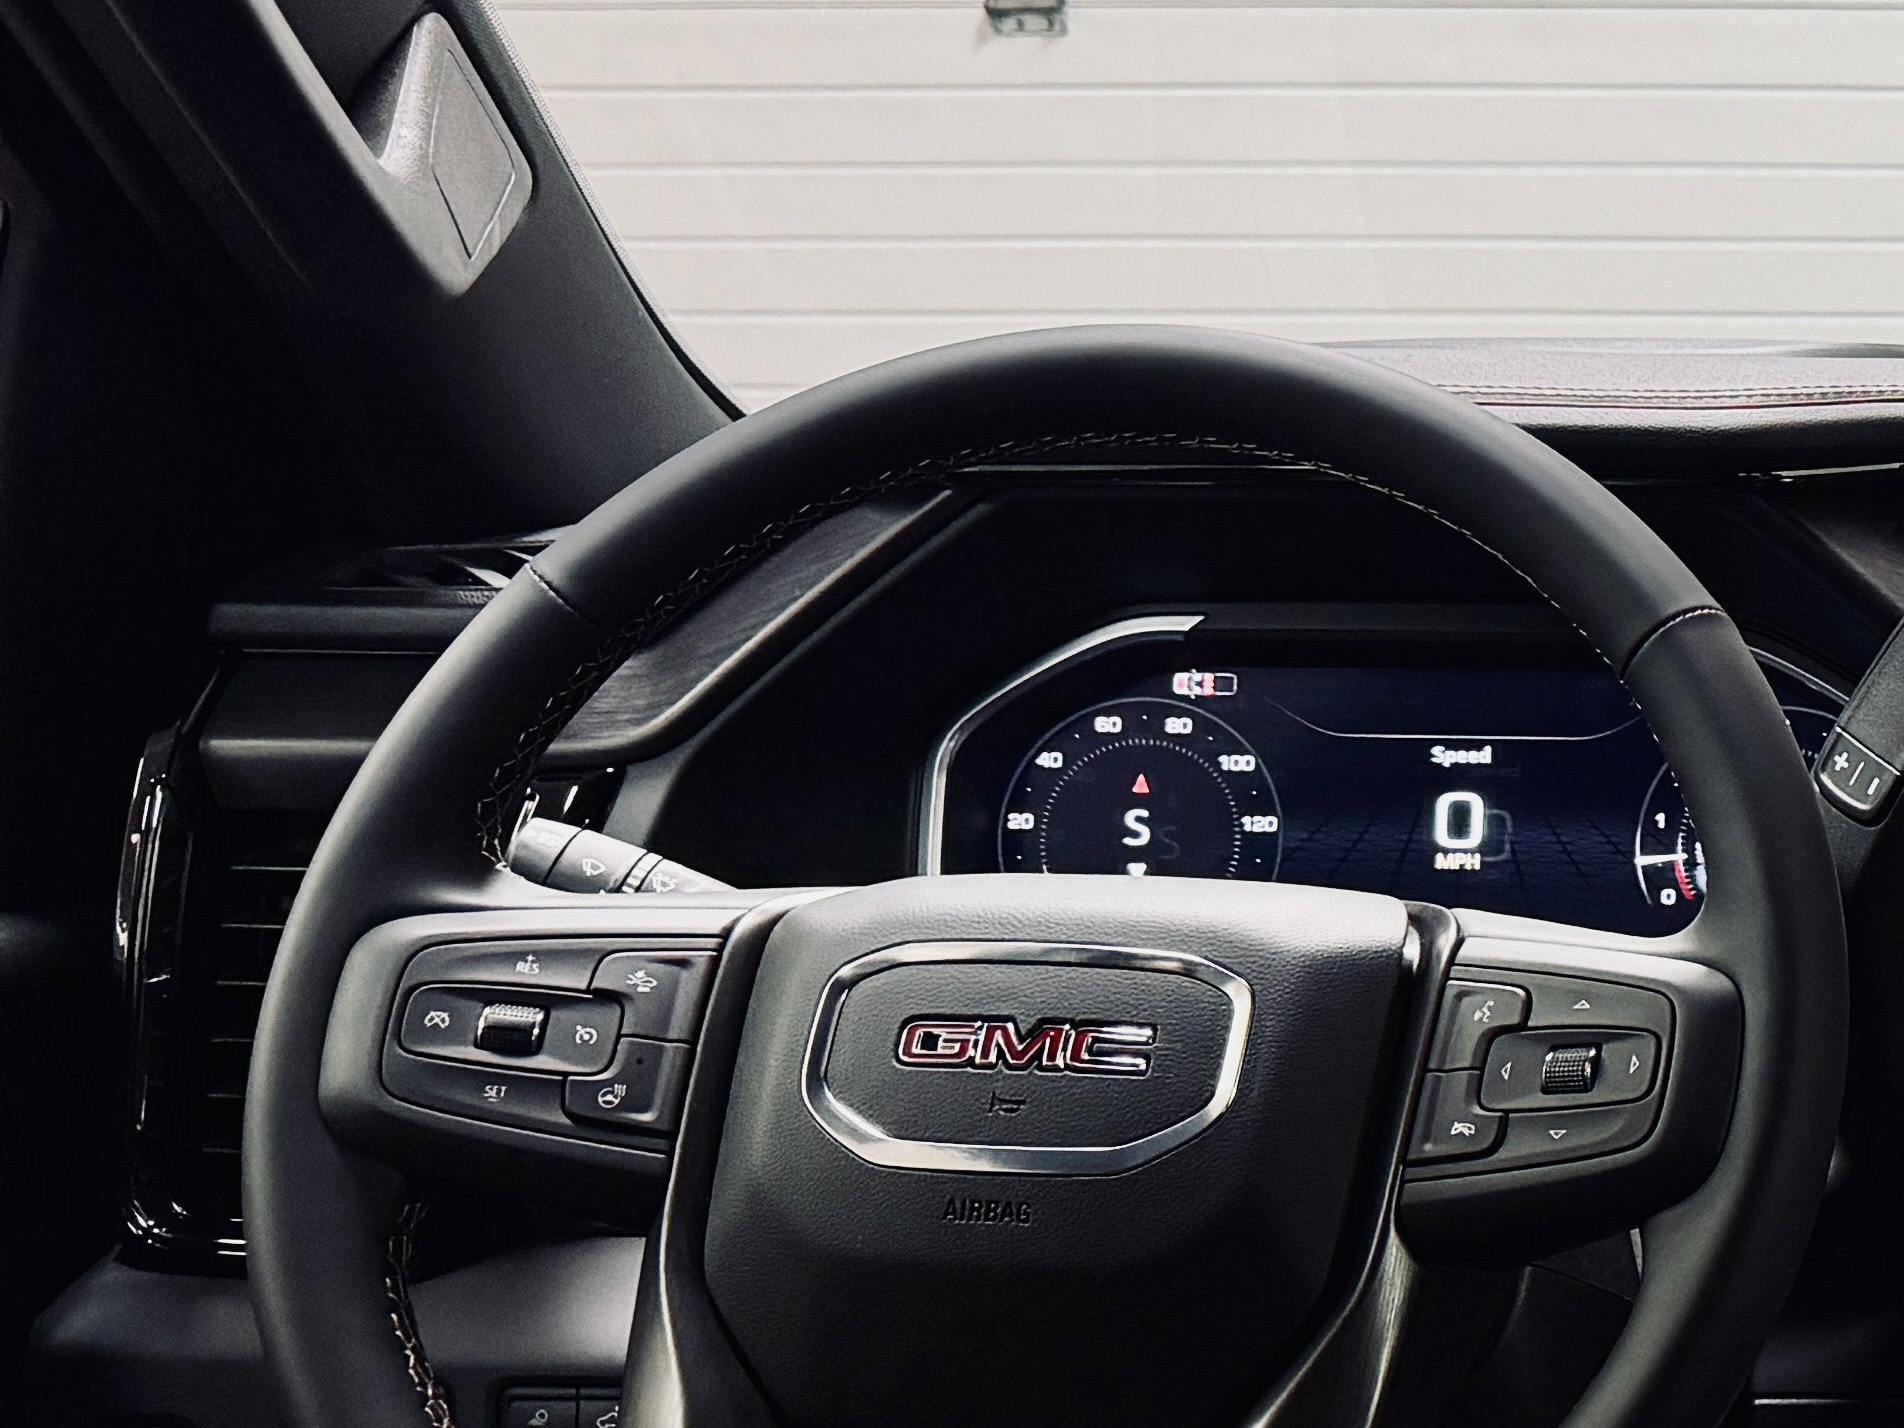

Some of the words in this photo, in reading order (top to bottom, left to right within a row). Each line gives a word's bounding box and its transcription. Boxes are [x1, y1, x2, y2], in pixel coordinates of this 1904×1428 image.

[1093, 716, 1123, 734] 60
[1164, 717, 1193, 734] 80
[1034, 751, 1063, 769] 40
[1217, 754, 1256, 772] 100
[1430, 745, 1492, 768] Speed
[1006, 812, 1035, 830] 20
[1121, 808, 1151, 847] S
[1239, 815, 1279, 833] 120
[1434, 791, 1485, 850] 0
[1654, 812, 1666, 829] 1
[1434, 852, 1482, 870] MPH
[1660, 888, 1677, 906] 0
[514, 961, 541, 974] RES
[899, 1019, 1155, 1074] GMC
[483, 1084, 507, 1098] SET
[942, 1197, 1032, 1226] AIRBAG
